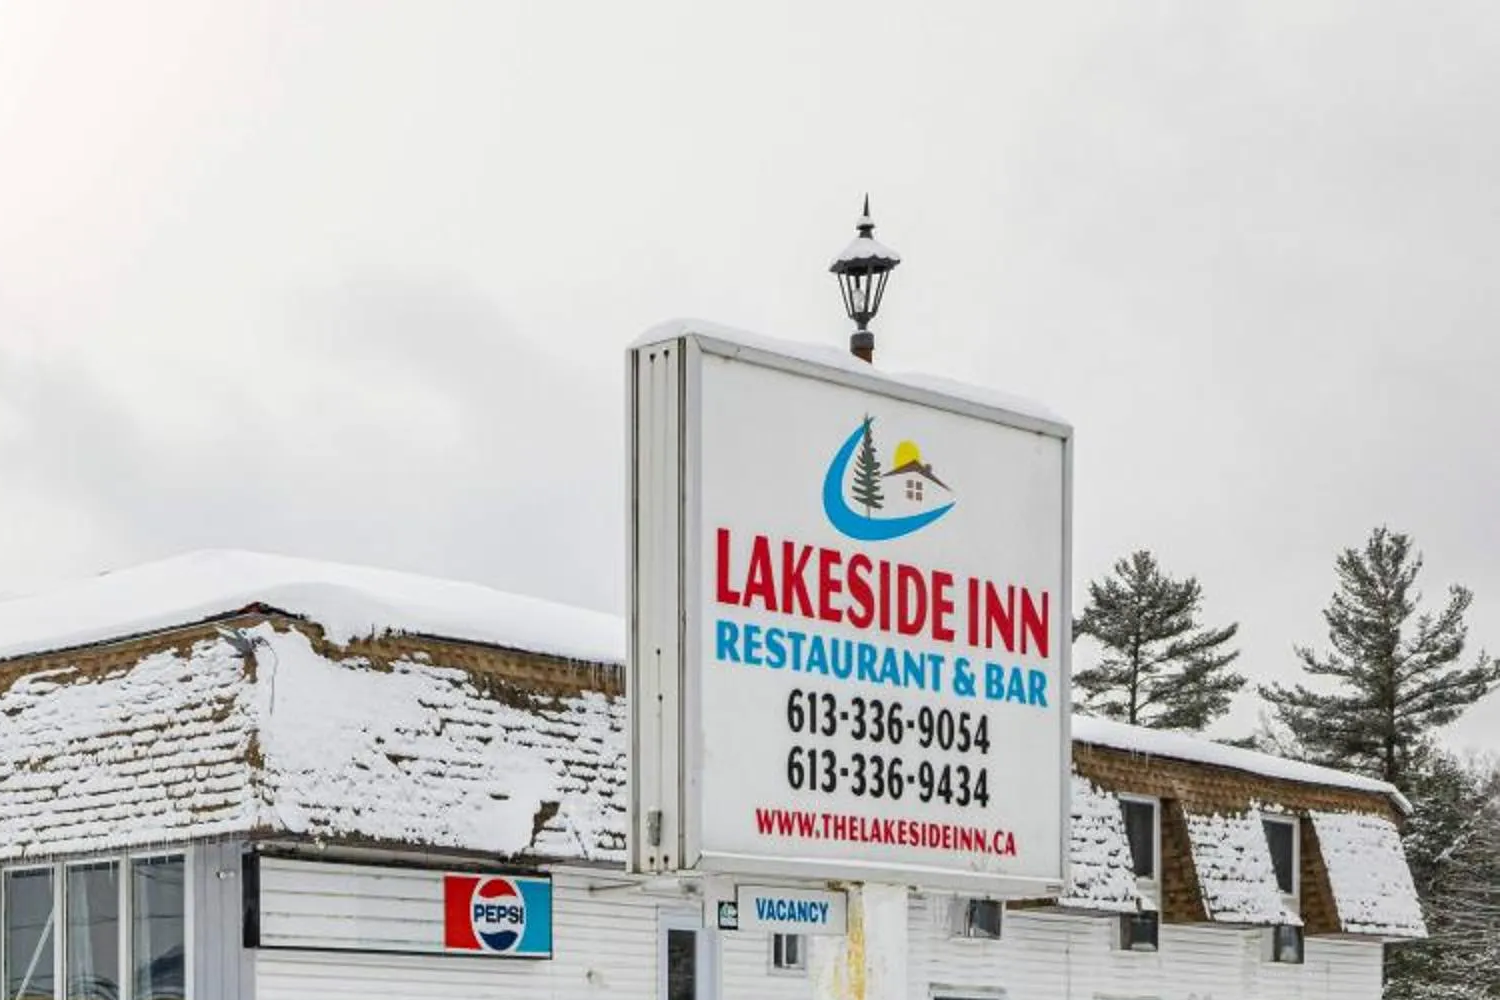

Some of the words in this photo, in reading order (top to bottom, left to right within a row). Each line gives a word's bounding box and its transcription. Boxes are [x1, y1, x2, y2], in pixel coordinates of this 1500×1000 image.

[715, 527, 955, 643] LAKESIDE
[969, 577, 1050, 659] INN
[716, 619, 946, 692] RESTAURANT
[952, 663, 977, 696] &
[985, 664, 1048, 708] BAR
[787, 688, 991, 754] 613-336-9054
[787, 746, 990, 808] 613-336-9434
[756, 808, 1017, 857] WWW.THELAKESIDEINN.CA
[474, 904, 524, 924] PEPSI
[756, 898, 829, 923] VACANCY
